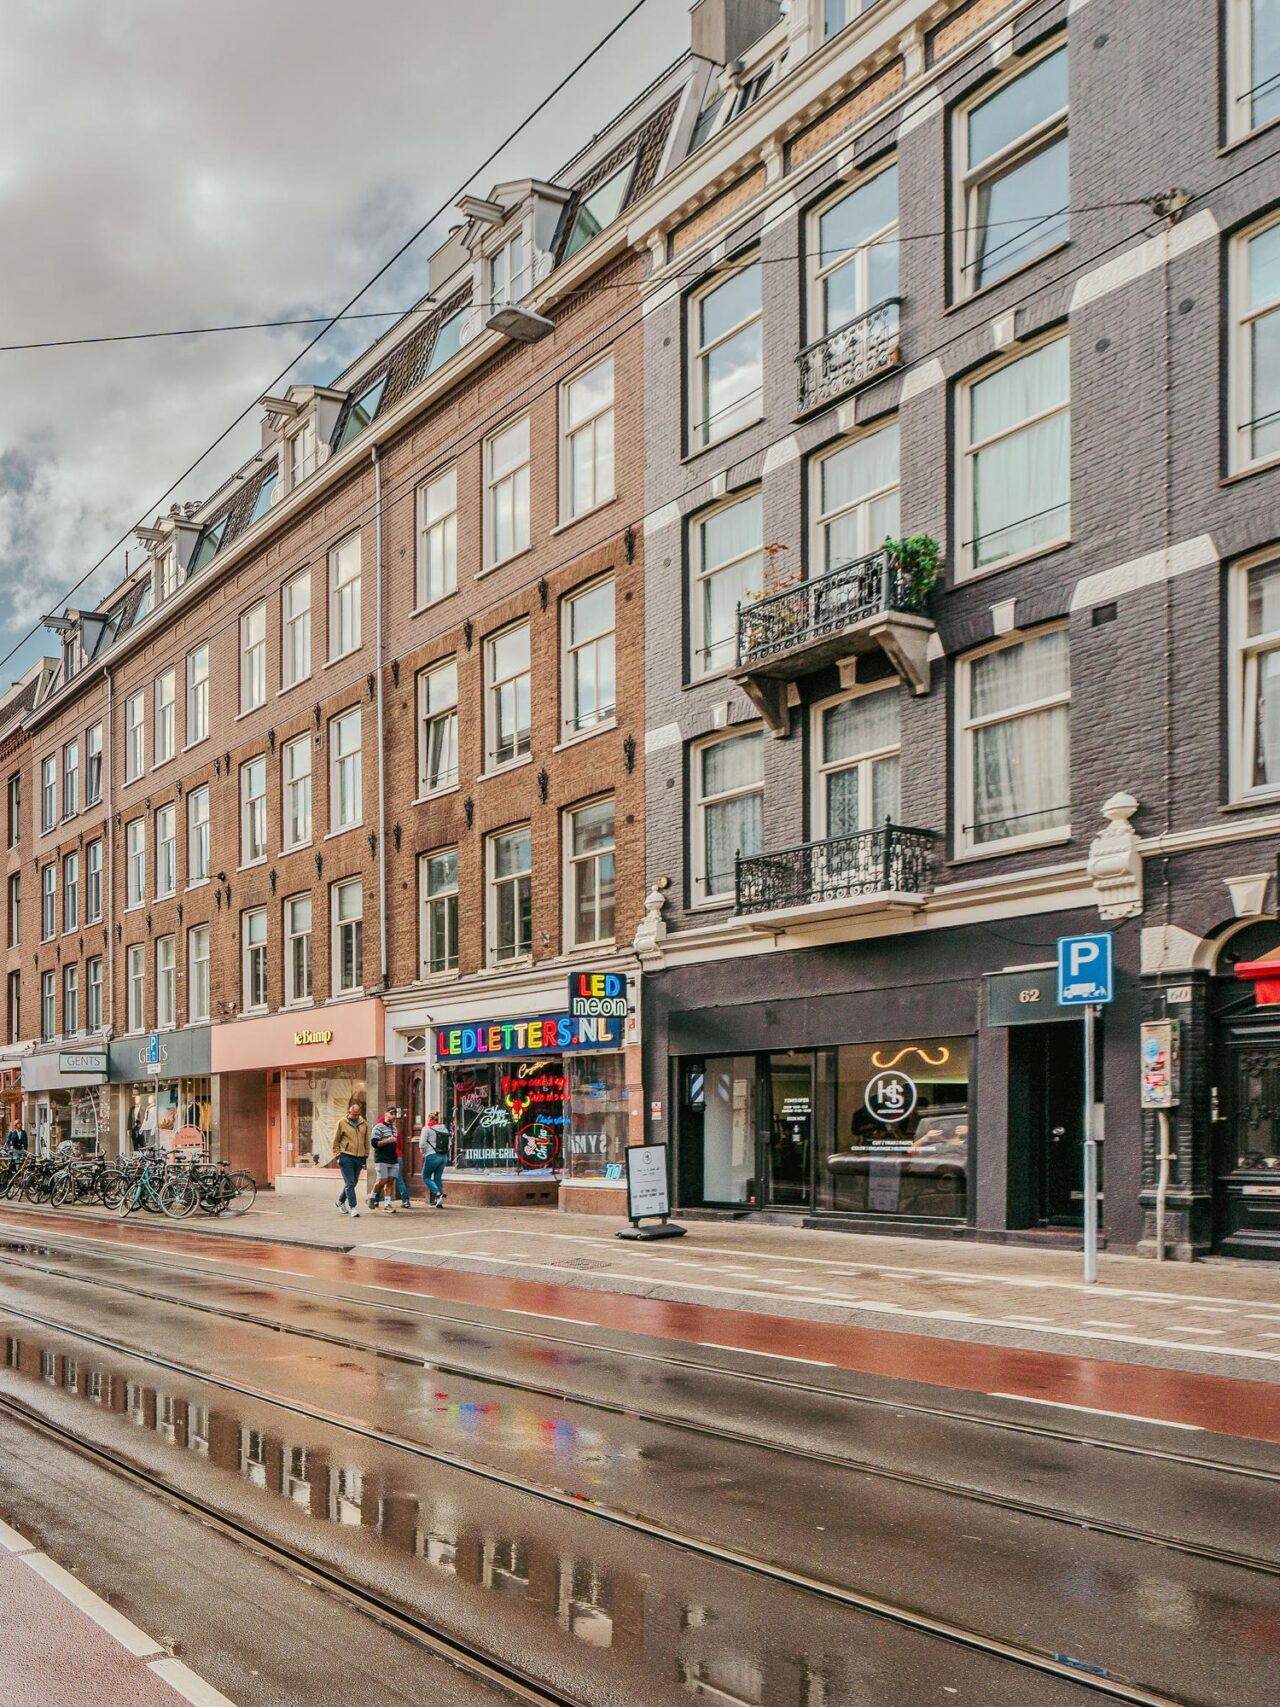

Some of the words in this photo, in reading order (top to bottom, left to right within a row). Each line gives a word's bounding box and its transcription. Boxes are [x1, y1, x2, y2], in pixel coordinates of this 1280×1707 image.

[1070, 941, 1100, 977] P
[578, 974, 622, 997] LED
[1019, 988, 1041, 1004] 62
[572, 998, 628, 1017] neon
[150, 1036, 156, 1051] P
[437, 1017, 614, 1056] LEDLETTERS.NL
[66, 1055, 102, 1067] GENTS
[138, 1043, 169, 1064] GETS
